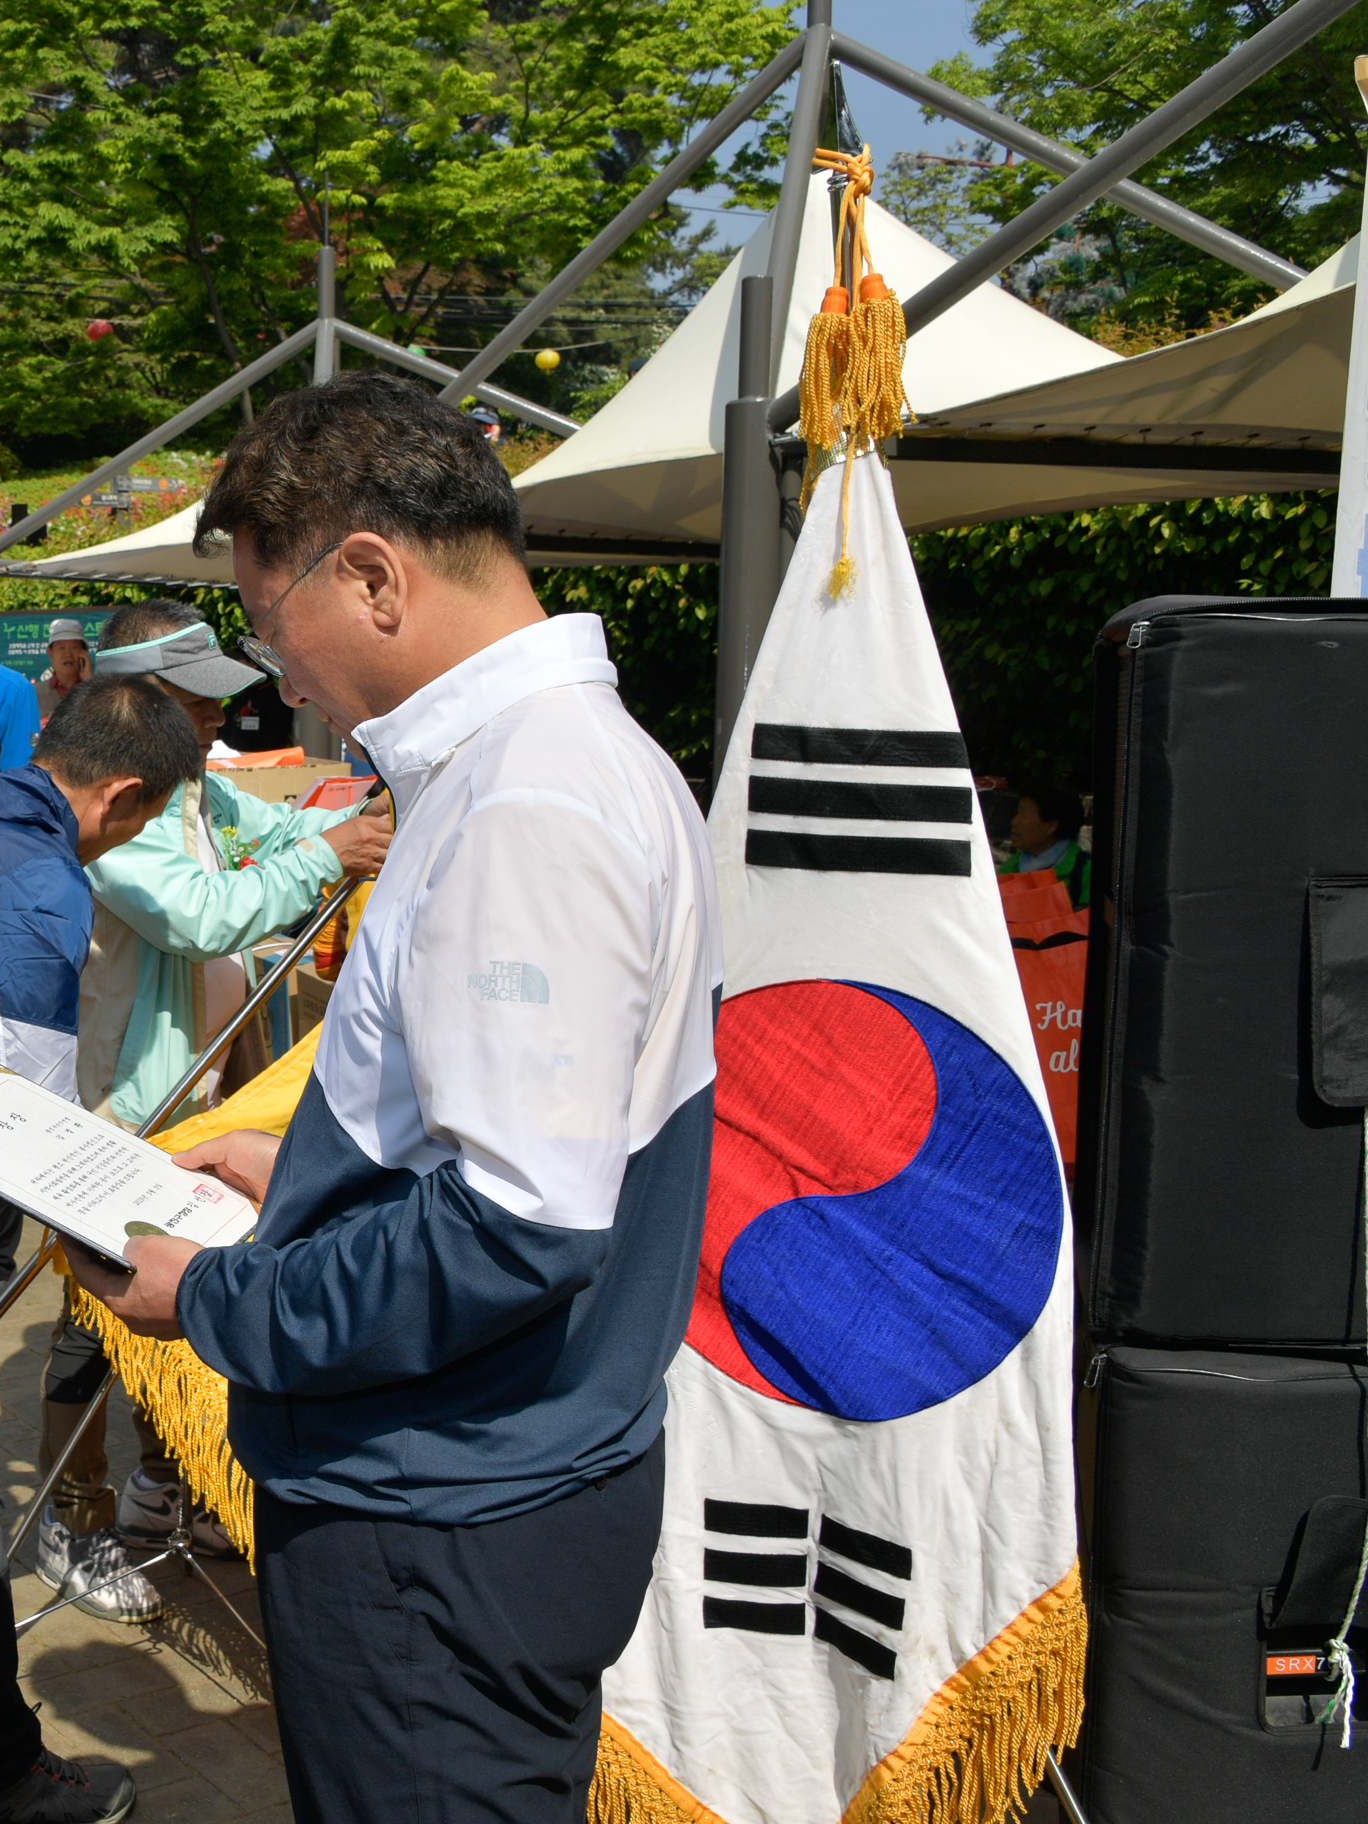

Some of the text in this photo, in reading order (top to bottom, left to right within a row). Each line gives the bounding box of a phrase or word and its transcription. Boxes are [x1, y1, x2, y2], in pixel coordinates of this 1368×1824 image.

[489, 960, 522, 975] THE
[467, 973, 521, 989] NORTH
[479, 987, 520, 1002] FACE
[1275, 1656, 1338, 1672] SRX7
